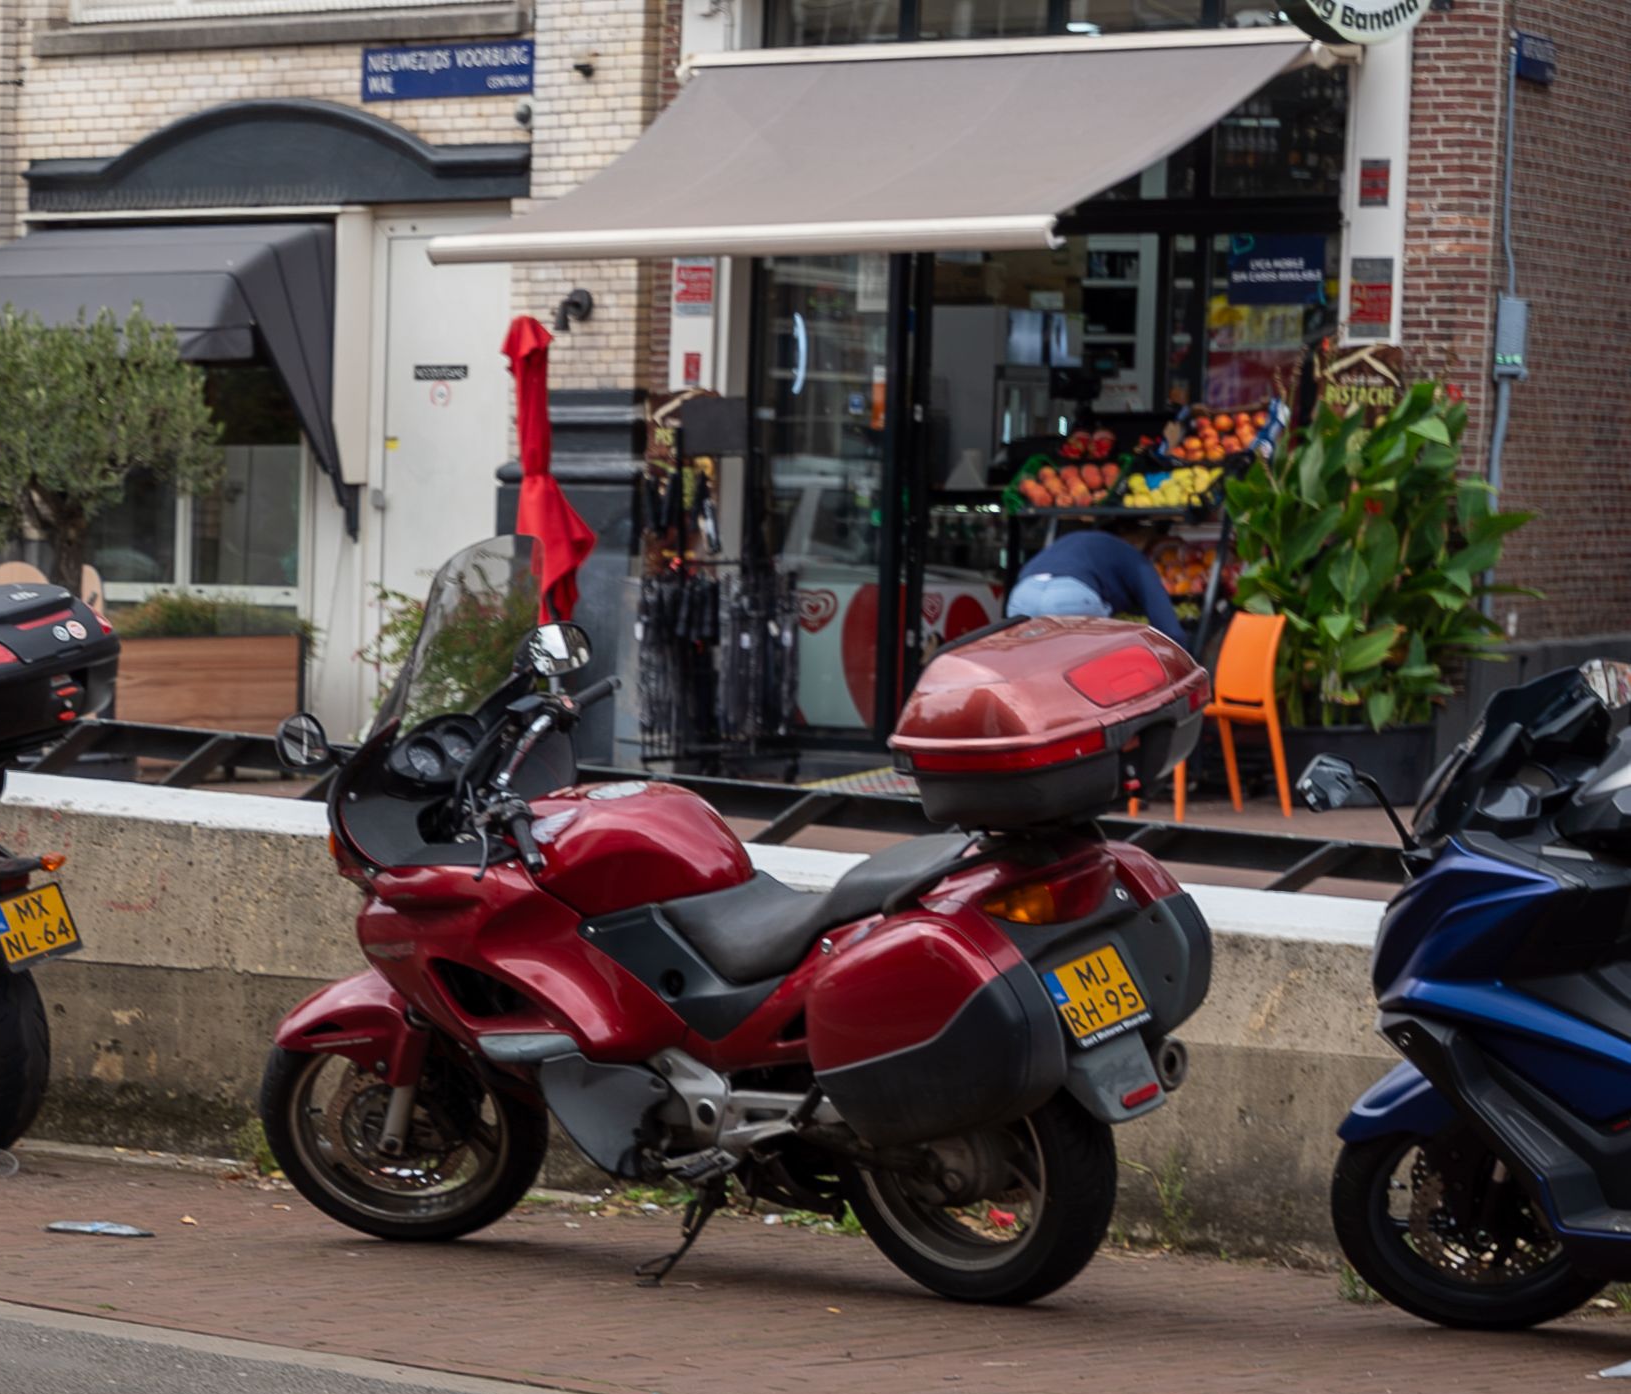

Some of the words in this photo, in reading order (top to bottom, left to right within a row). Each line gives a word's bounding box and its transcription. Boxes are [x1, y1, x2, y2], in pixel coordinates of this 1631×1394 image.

[1341, 0, 1419, 31] Banana
[367, 50, 451, 74] NIEUWEZIJDS
[455, 45, 530, 68] VOORBURG
[367, 74, 395, 95] WAL
[486, 74, 530, 89] CENTRUM
[13, 894, 50, 925] MX
[3, 916, 71, 959] NL-64
[1073, 955, 1110, 992] MJ
[1064, 981, 1139, 1034] RH-95
